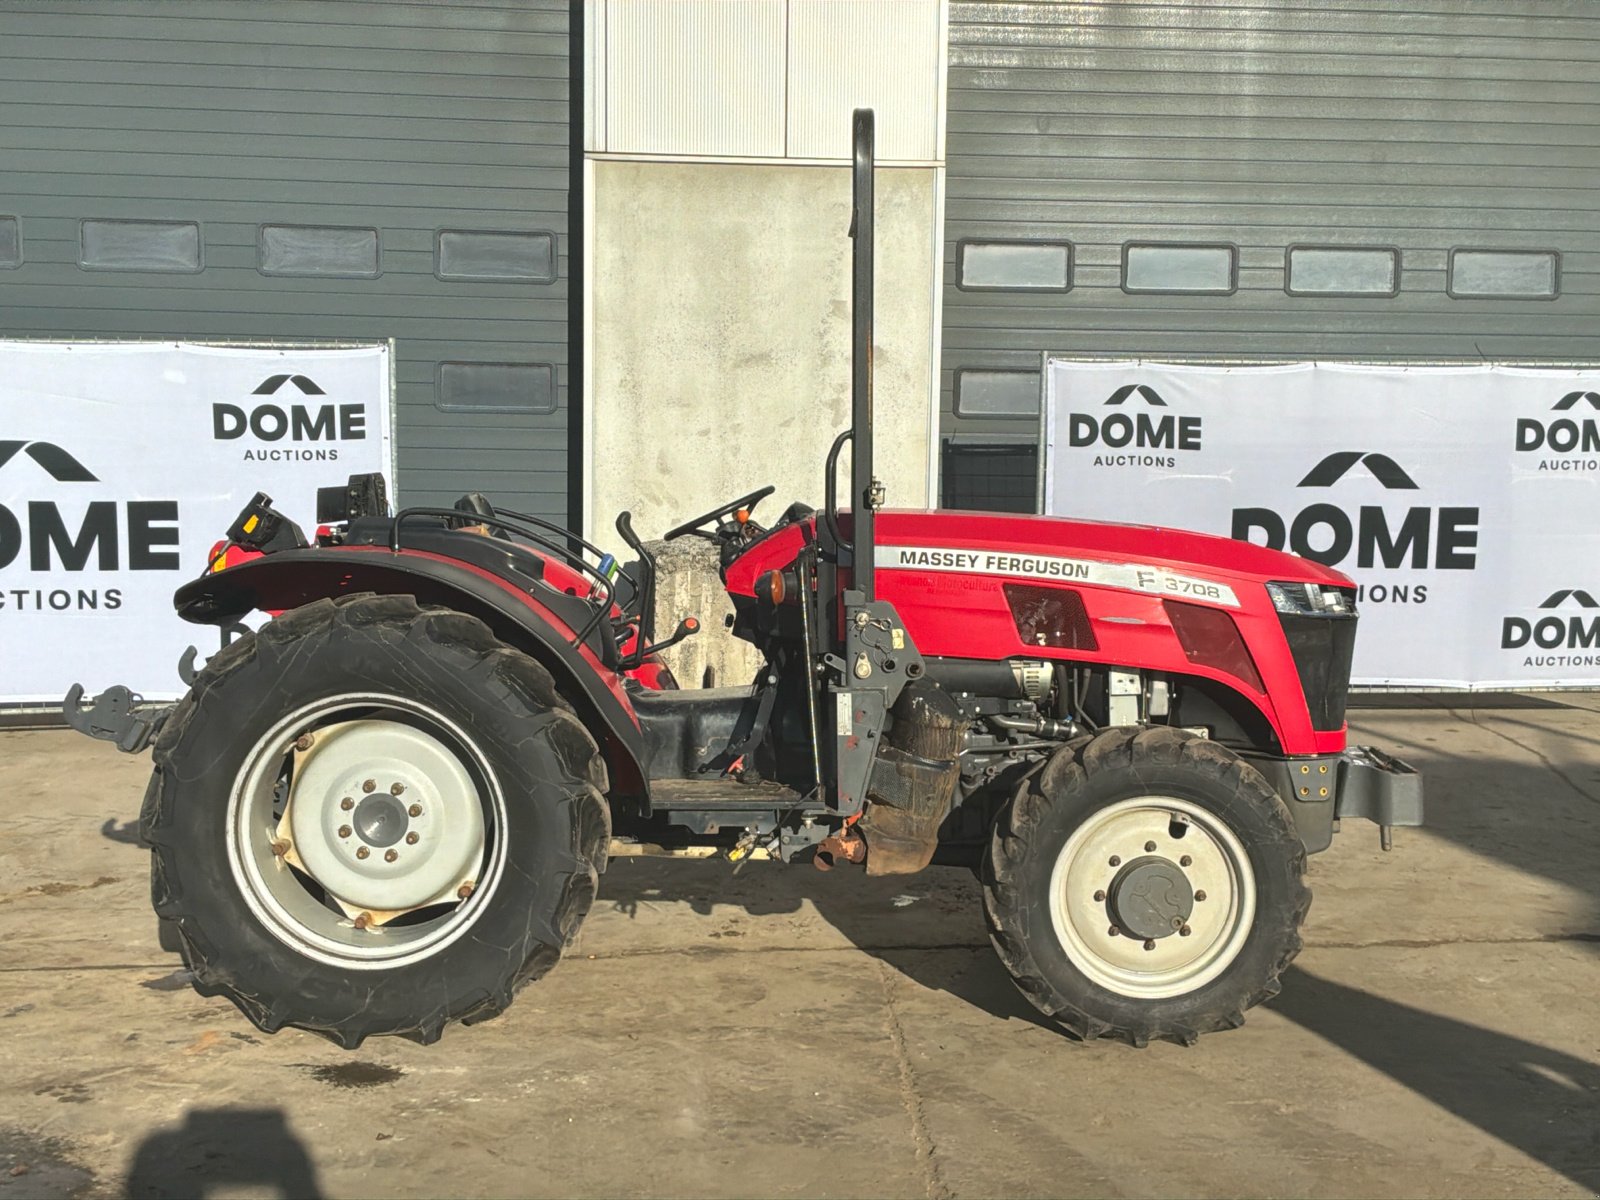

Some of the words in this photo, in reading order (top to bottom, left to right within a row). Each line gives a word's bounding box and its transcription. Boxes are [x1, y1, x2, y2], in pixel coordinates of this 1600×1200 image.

[213, 403, 366, 441] DOME
[1069, 413, 1202, 450] DOME
[244, 449, 338, 461] AUCTIONS
[1093, 456, 1175, 467] AUCTIONS
[1538, 460, 1600, 470] AUCTIO
[0, 500, 180, 571] ME
[1231, 503, 1479, 569] DOME
[900, 551, 979, 568] MASSEY
[986, 555, 1089, 578] FERGUSON
[1137, 570, 1155, 587] F
[1165, 578, 1220, 598] 3708
